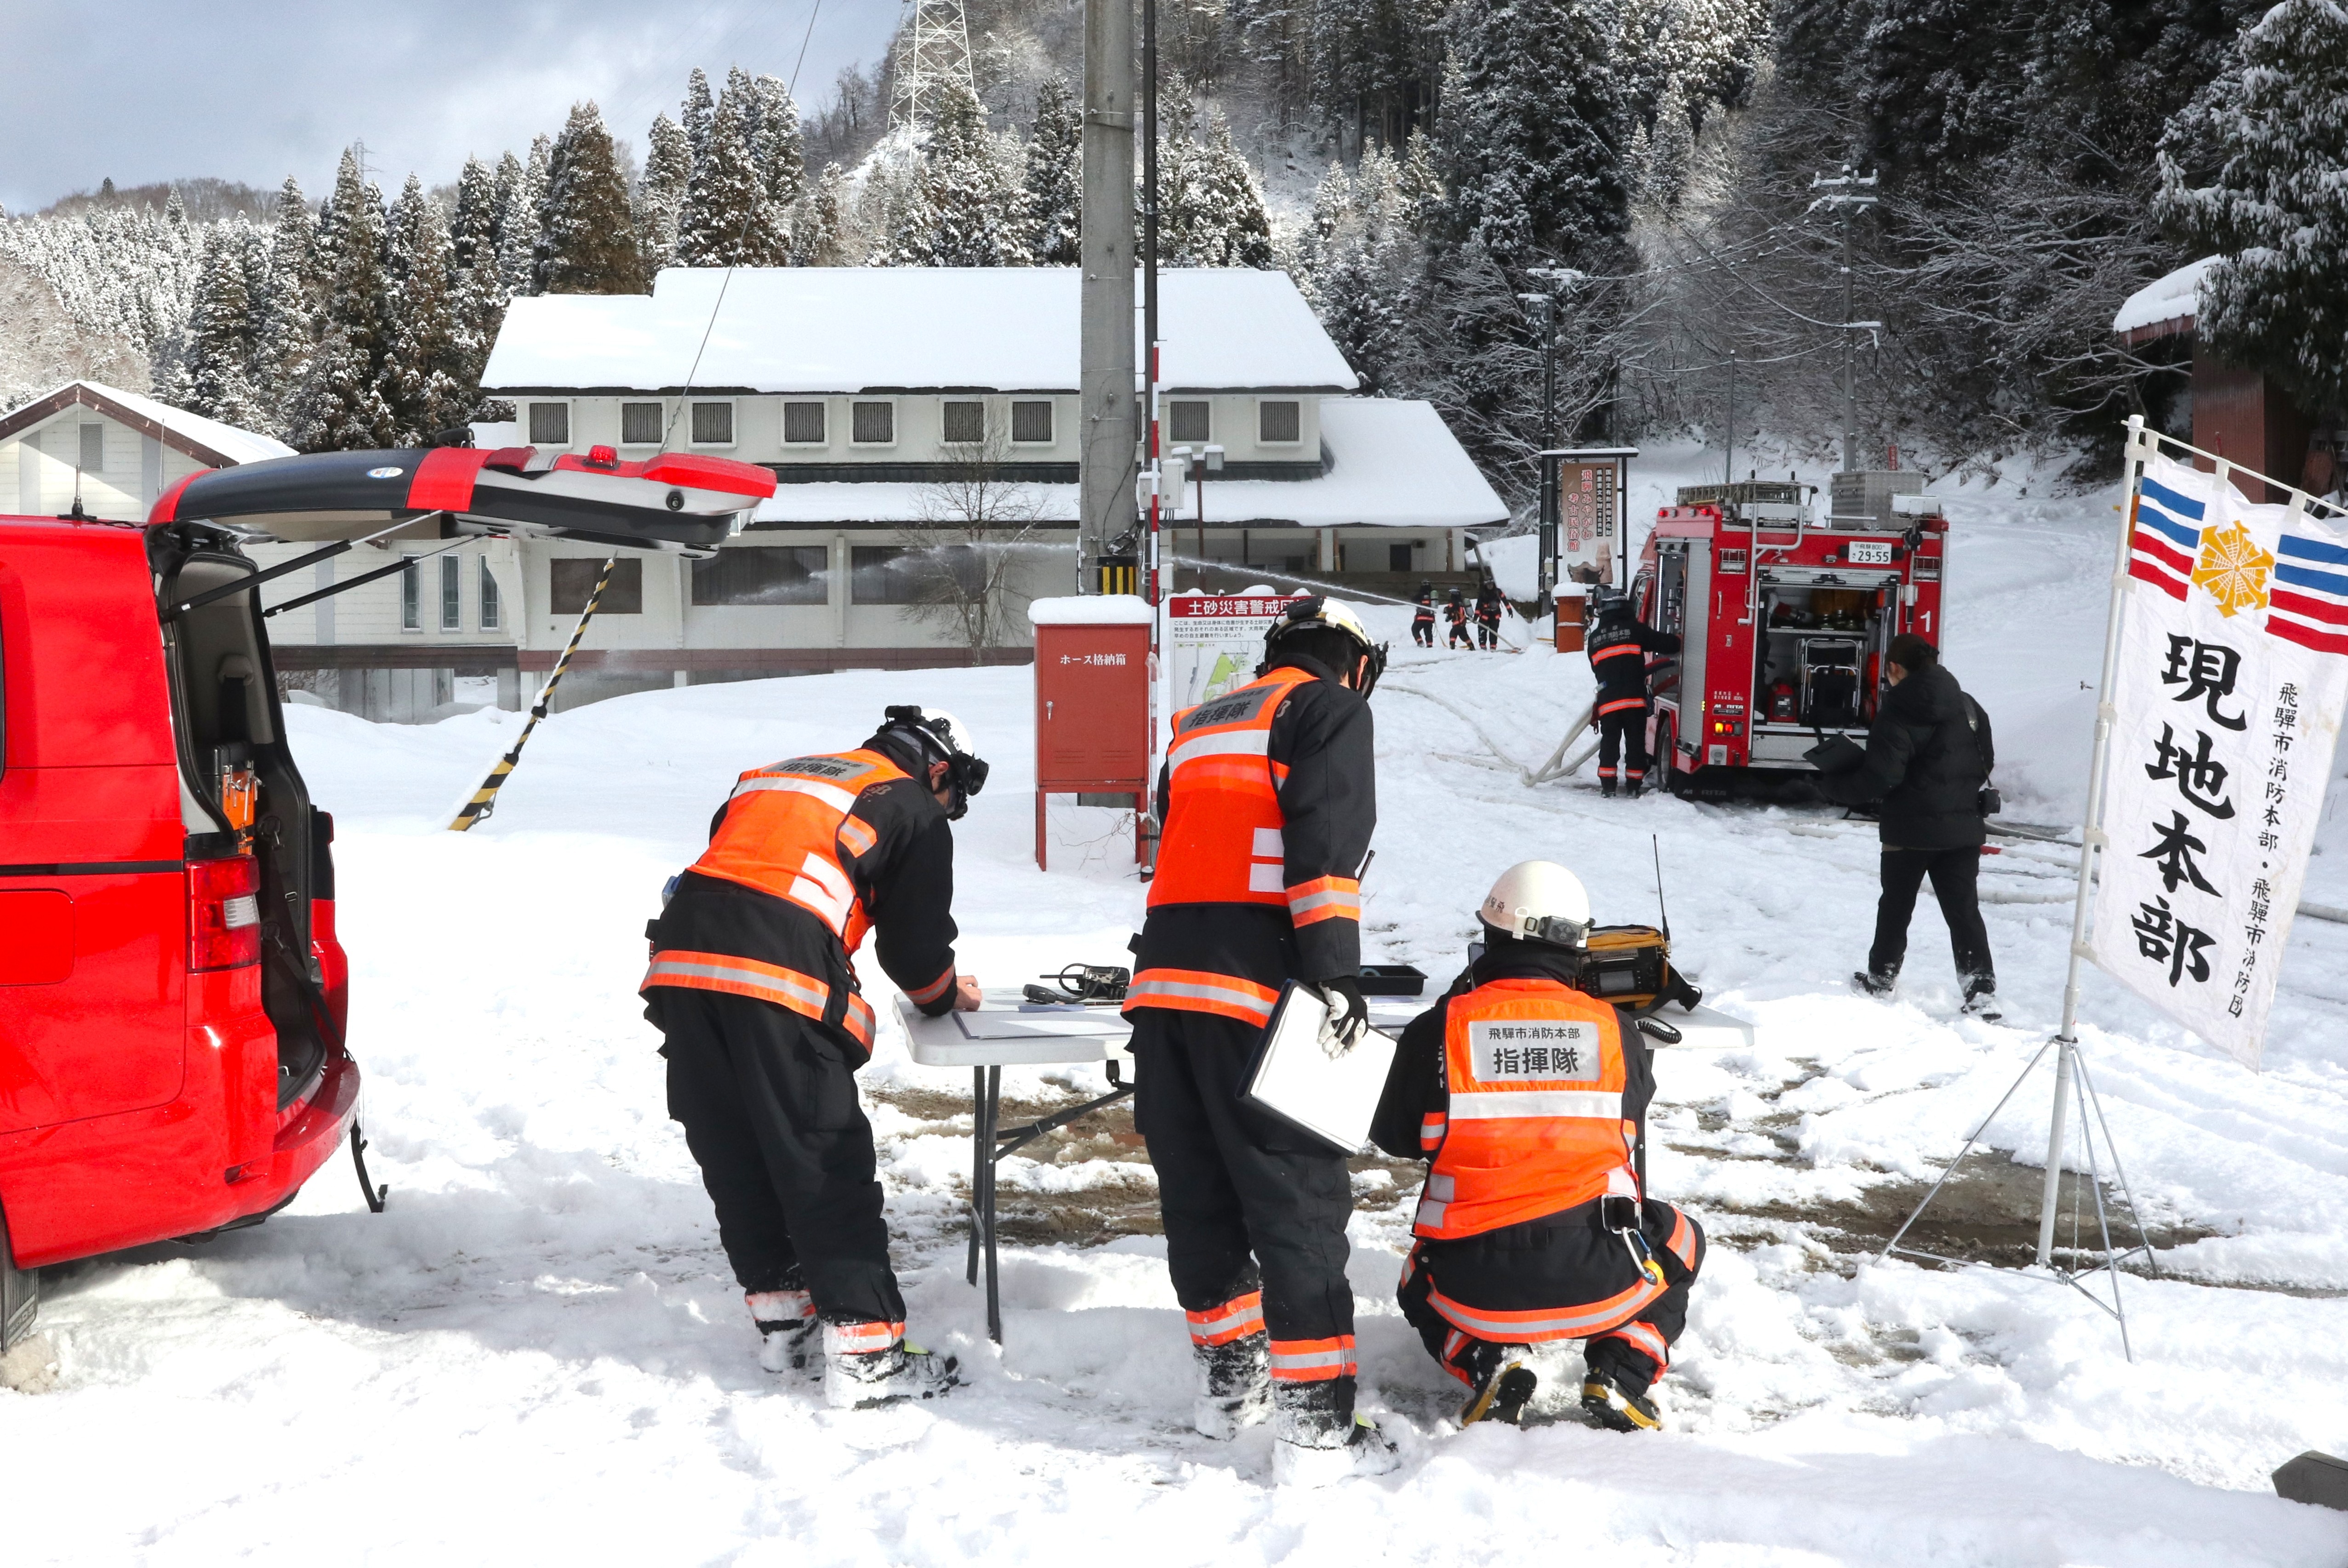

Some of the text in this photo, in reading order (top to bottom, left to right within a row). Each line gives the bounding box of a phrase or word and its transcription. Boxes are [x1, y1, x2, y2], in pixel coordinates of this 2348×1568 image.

[1567, 492, 1580, 551] 考古民俗館
[1858, 551, 1889, 562] 29-55
[1188, 599, 1299, 615] 土砂災害警戒区
[1920, 610, 1931, 632] 1
[1060, 653, 1126, 665] ホース格納箱
[1188, 700, 1252, 727] 指揮隊
[780, 762, 847, 777] 指揮隊
[2131, 631, 2247, 987] 現地本部
[1493, 1047, 1579, 1074] 指揮隊
